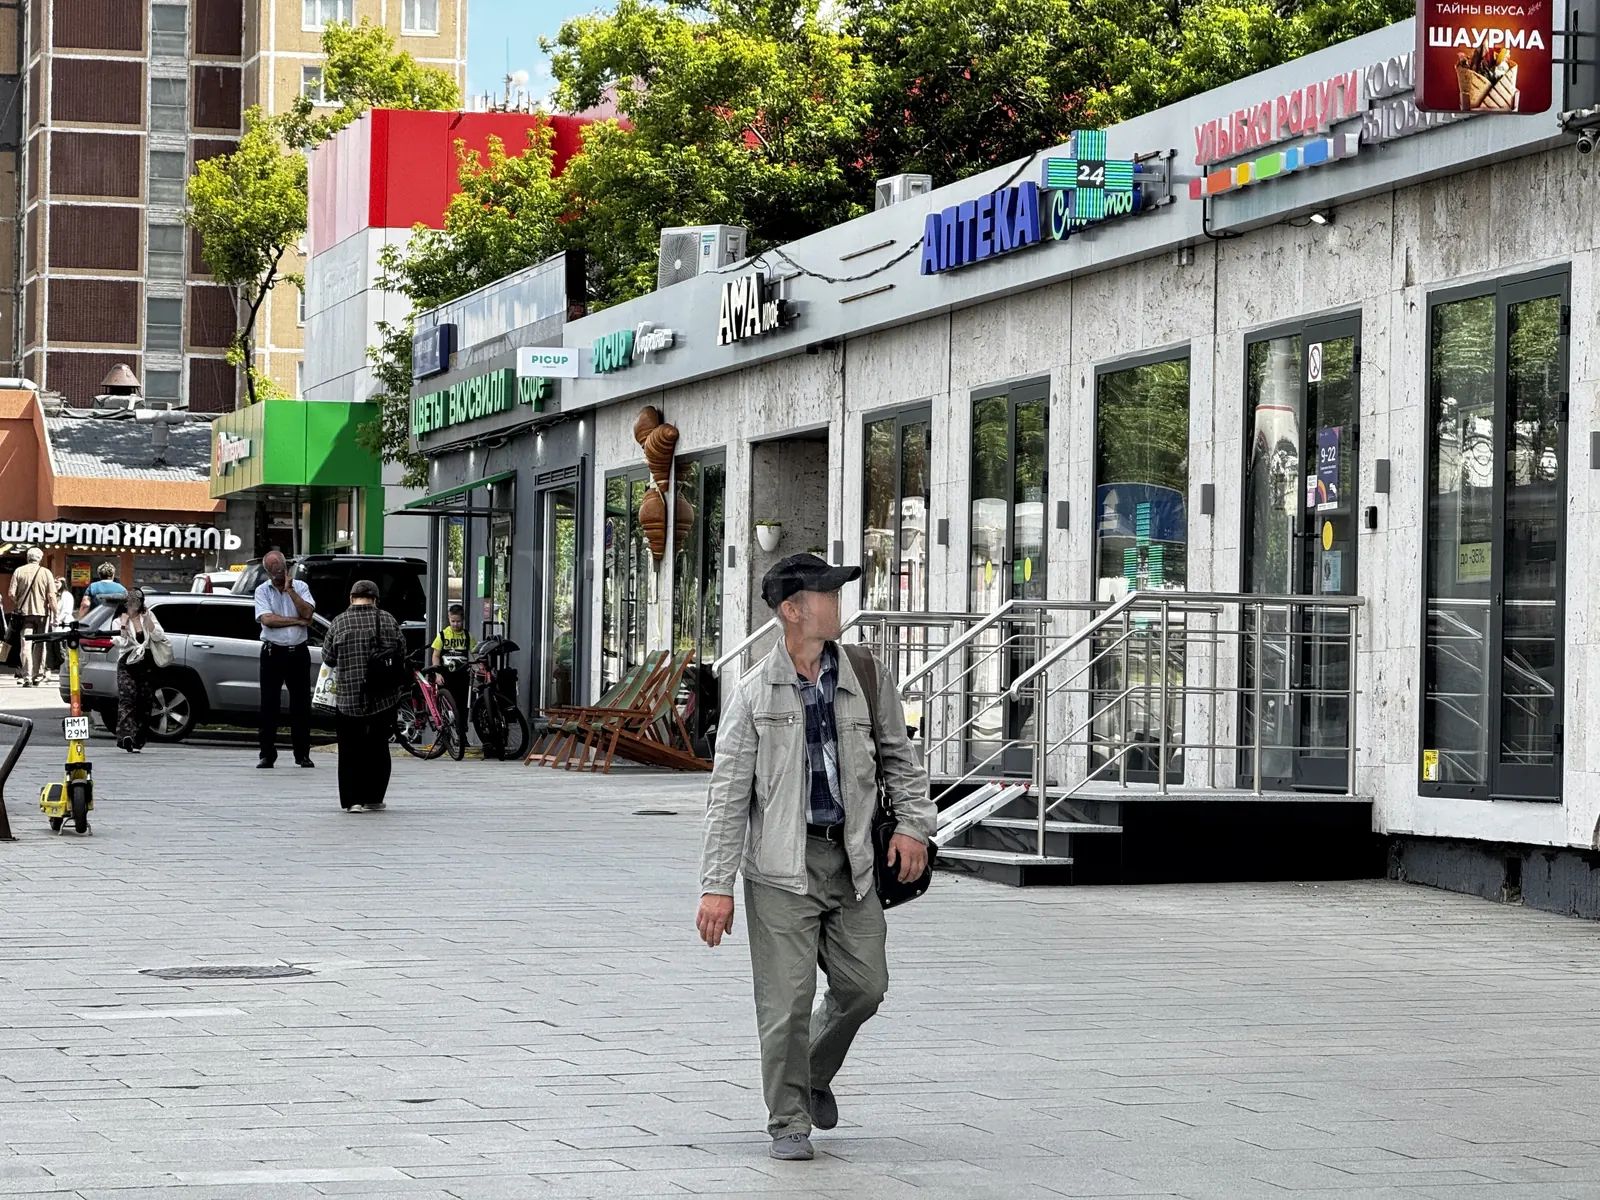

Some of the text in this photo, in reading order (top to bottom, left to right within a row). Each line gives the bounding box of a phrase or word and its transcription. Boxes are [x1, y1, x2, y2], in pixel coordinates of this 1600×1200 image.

[1436, 2, 1525, 16] ТАЙНЫ ВКУСА
[1429, 26, 1545, 50] ШАУРМА
[1363, 50, 1415, 100] КОСМ
[1078, 165, 1105, 185] 24
[920, 181, 1040, 275] АПТЕКА
[531, 354, 569, 365] PICUP
[593, 329, 634, 374] PICUP
[412, 390, 446, 441] ЦВЕТЫ
[449, 368, 508, 426] ВКУСВИЛЛ
[1320, 446, 1336, 463] 9-22
[1, 520, 242, 551] ШАУРМА ХАЛЯЛЬ
